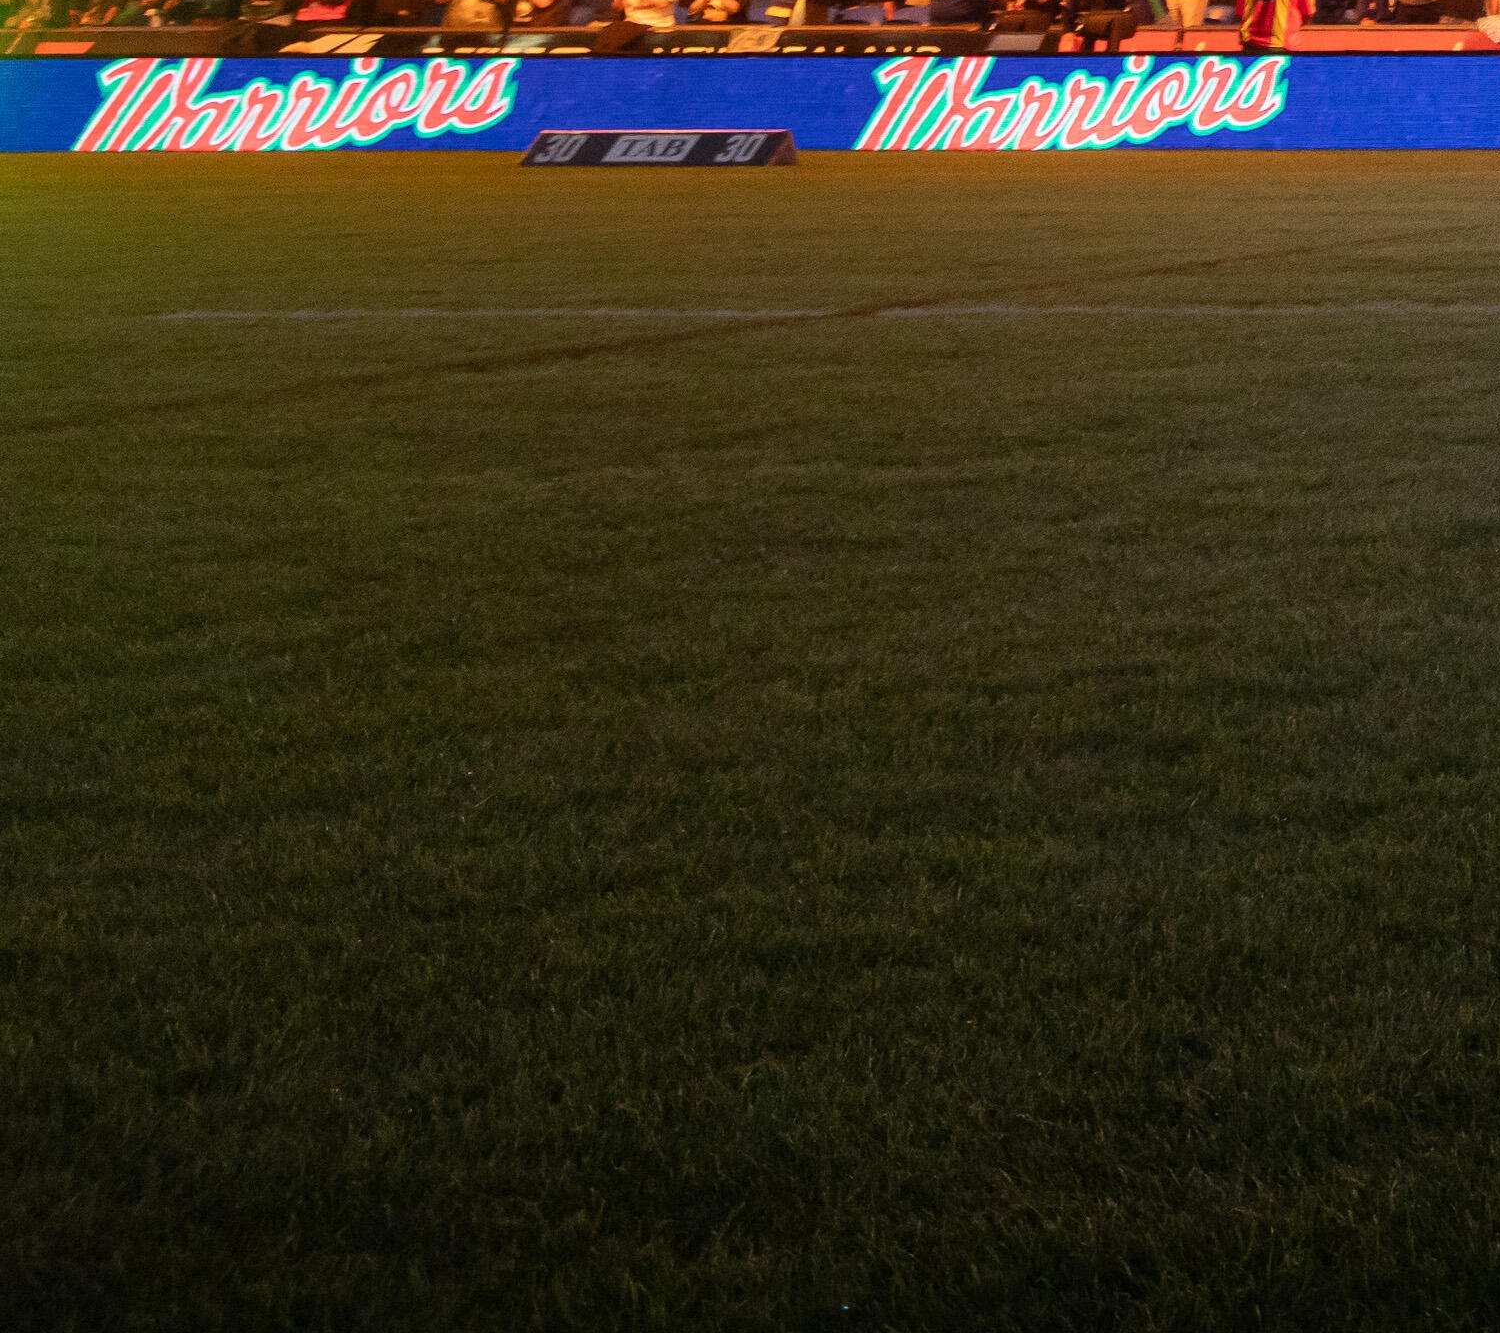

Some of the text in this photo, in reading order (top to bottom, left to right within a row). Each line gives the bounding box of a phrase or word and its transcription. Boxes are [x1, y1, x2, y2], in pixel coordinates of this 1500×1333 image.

[70, 58, 522, 151] Warriors
[535, 134, 767, 163] 30 TAB 30
[855, 56, 1290, 150] Warriors
